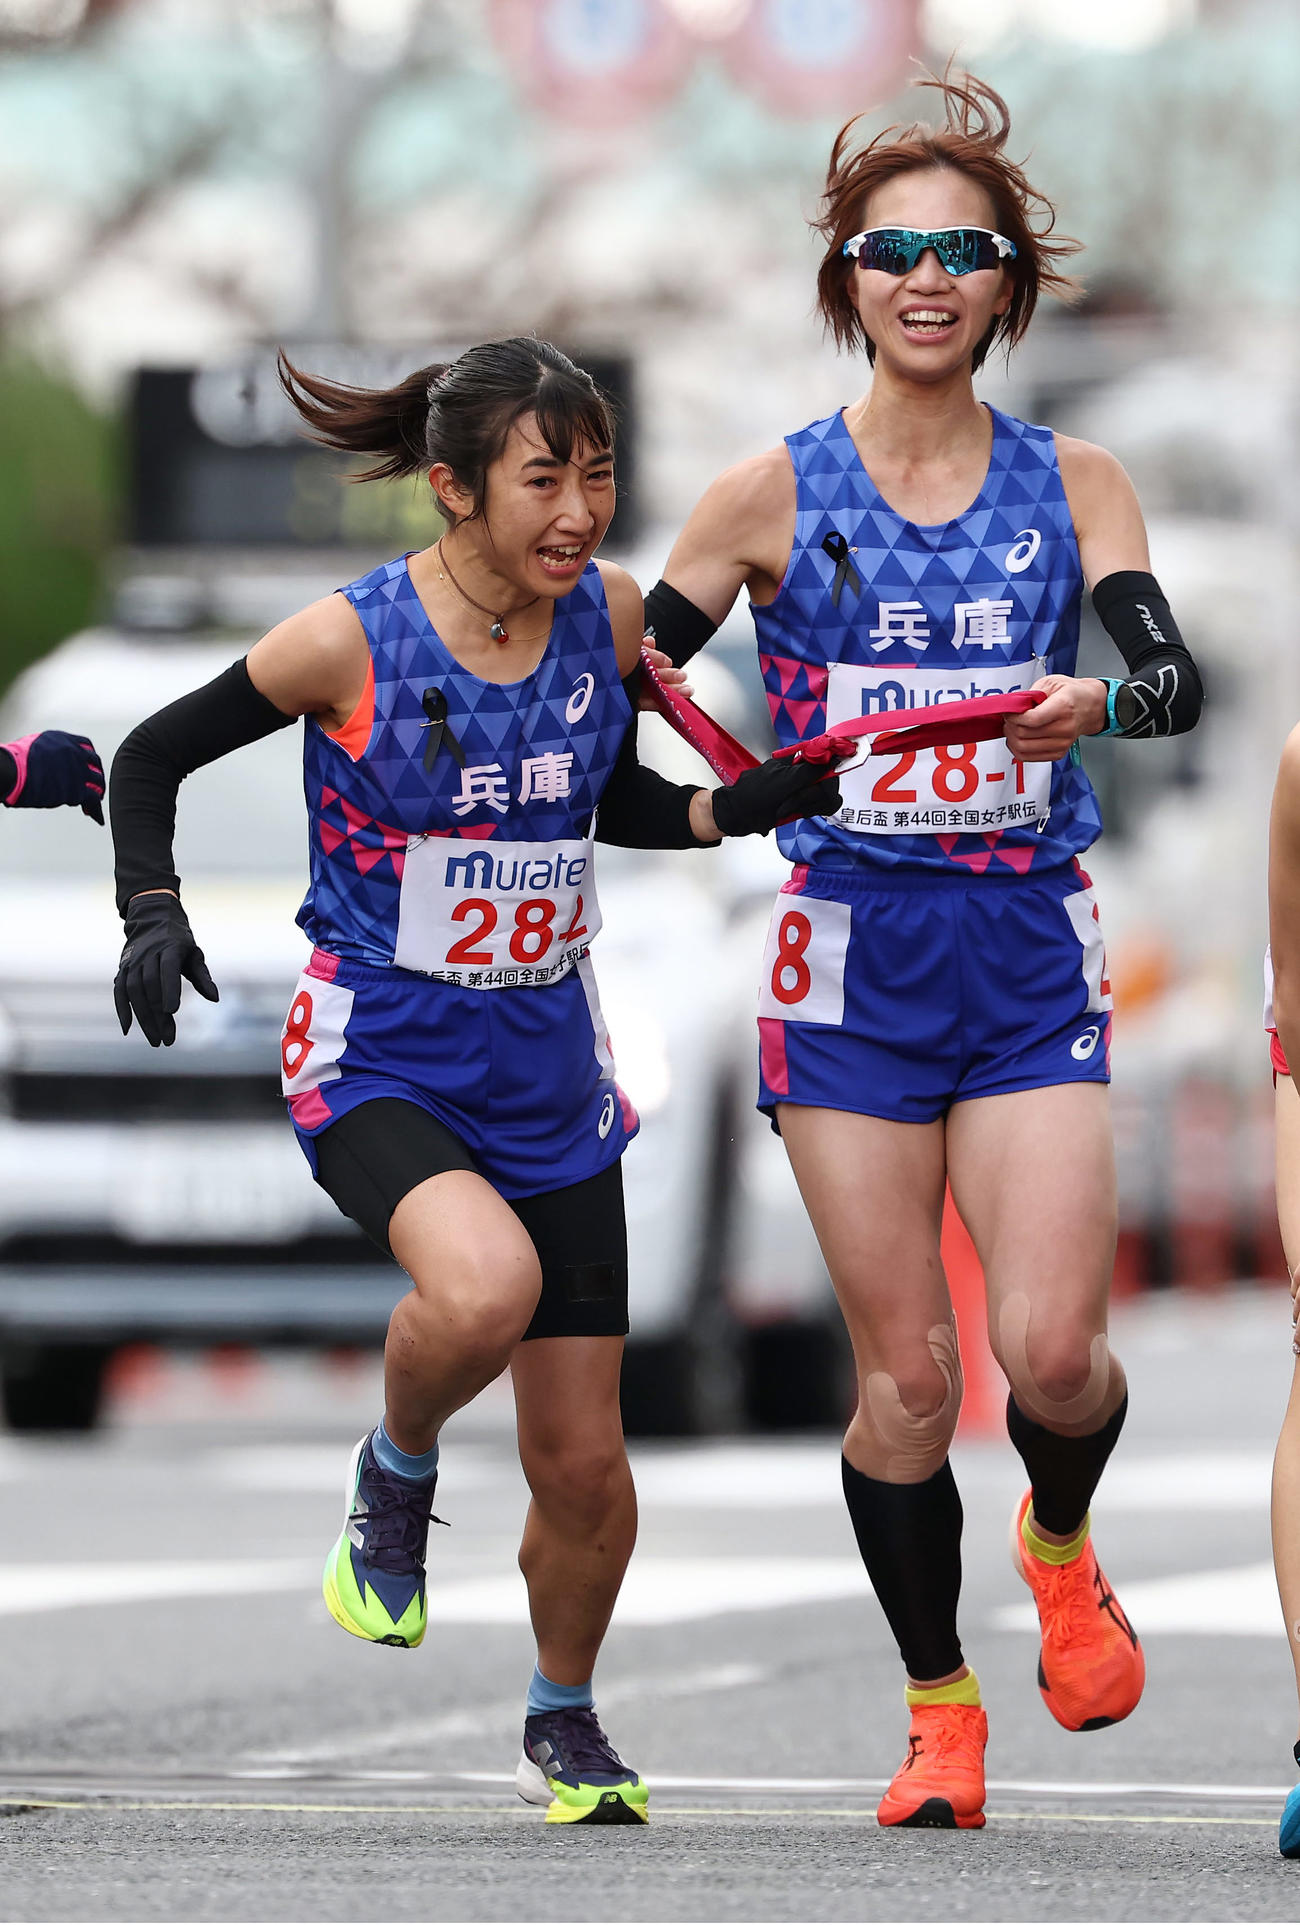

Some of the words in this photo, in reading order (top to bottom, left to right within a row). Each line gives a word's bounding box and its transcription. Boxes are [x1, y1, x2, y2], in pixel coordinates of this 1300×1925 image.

[869, 597, 1014, 651] 兵庫
[451, 751, 575, 816] 兵庫
[840, 807, 888, 827] 皇后盃
[893, 800, 1037, 828] 第44回全国女子駅伝
[770, 910, 812, 1005] 8
[281, 990, 315, 1080] 8
